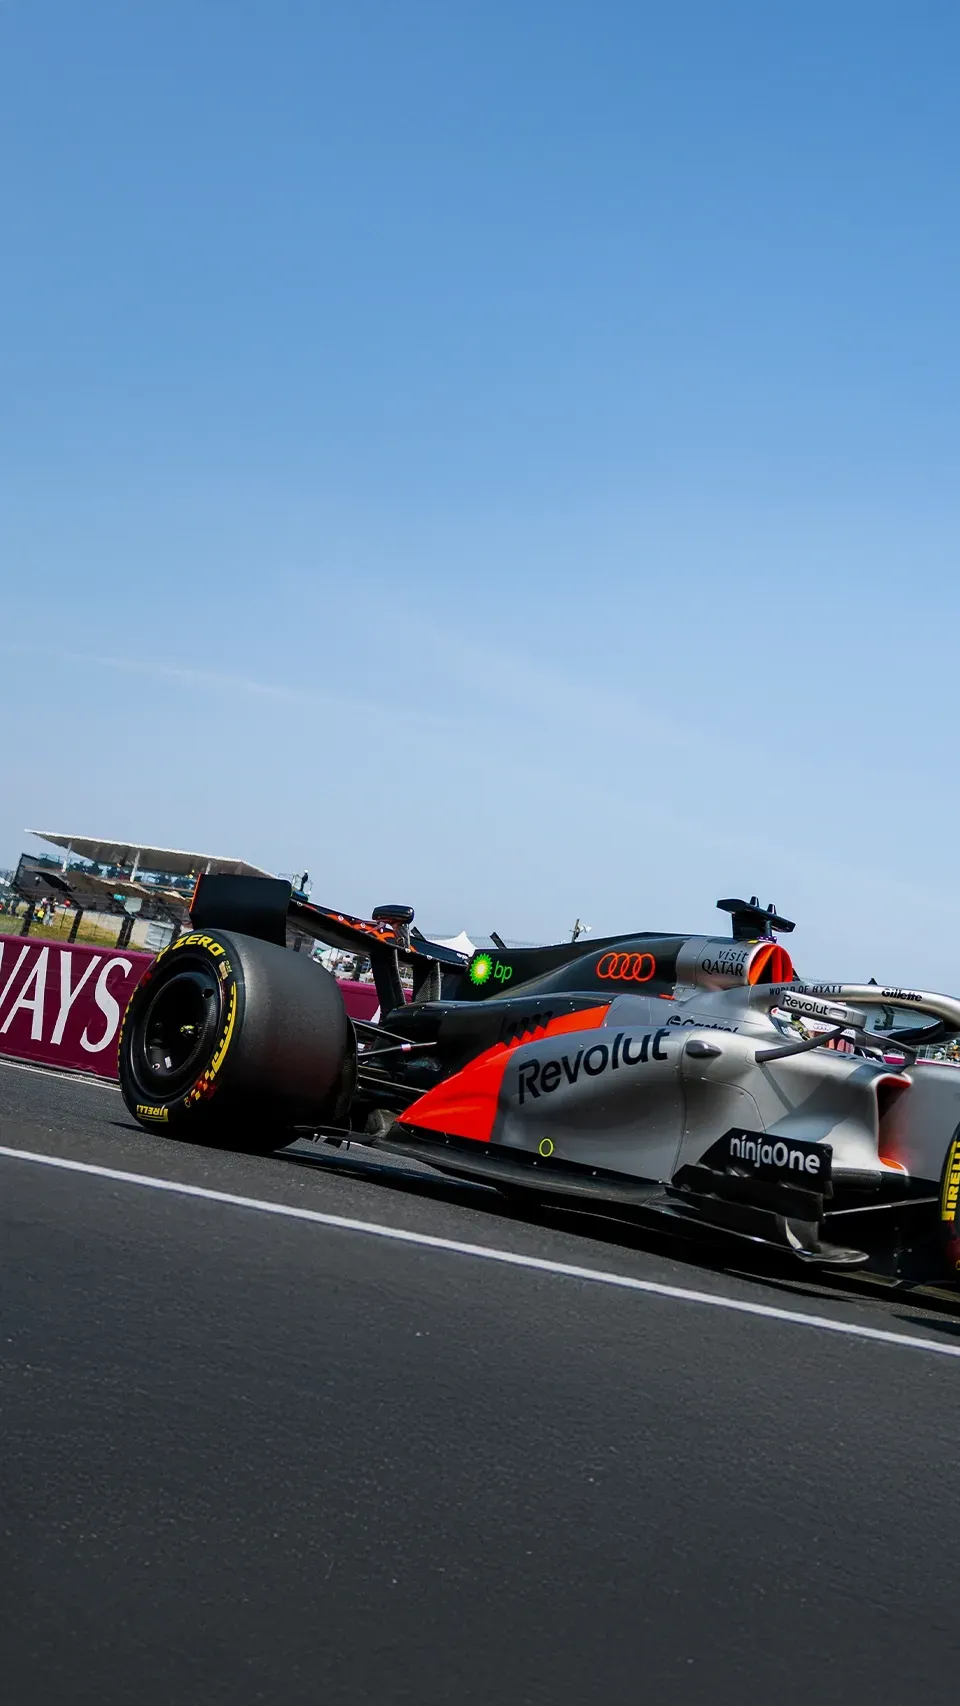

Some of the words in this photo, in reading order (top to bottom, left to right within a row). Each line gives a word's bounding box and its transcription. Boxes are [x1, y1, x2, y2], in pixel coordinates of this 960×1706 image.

[172, 934, 226, 956] ZERO
[719, 948, 750, 963] visit
[493, 960, 512, 984] bp
[701, 958, 745, 977] QATAR
[798, 985, 810, 994] OF
[812, 985, 843, 994] HYATT
[881, 987, 923, 1002] Gillette
[782, 994, 829, 1016] Revolut
[517, 1028, 672, 1105] Revolut
[136, 1104, 169, 1122] PIRELLI
[730, 1134, 820, 1174] ninjaOne
